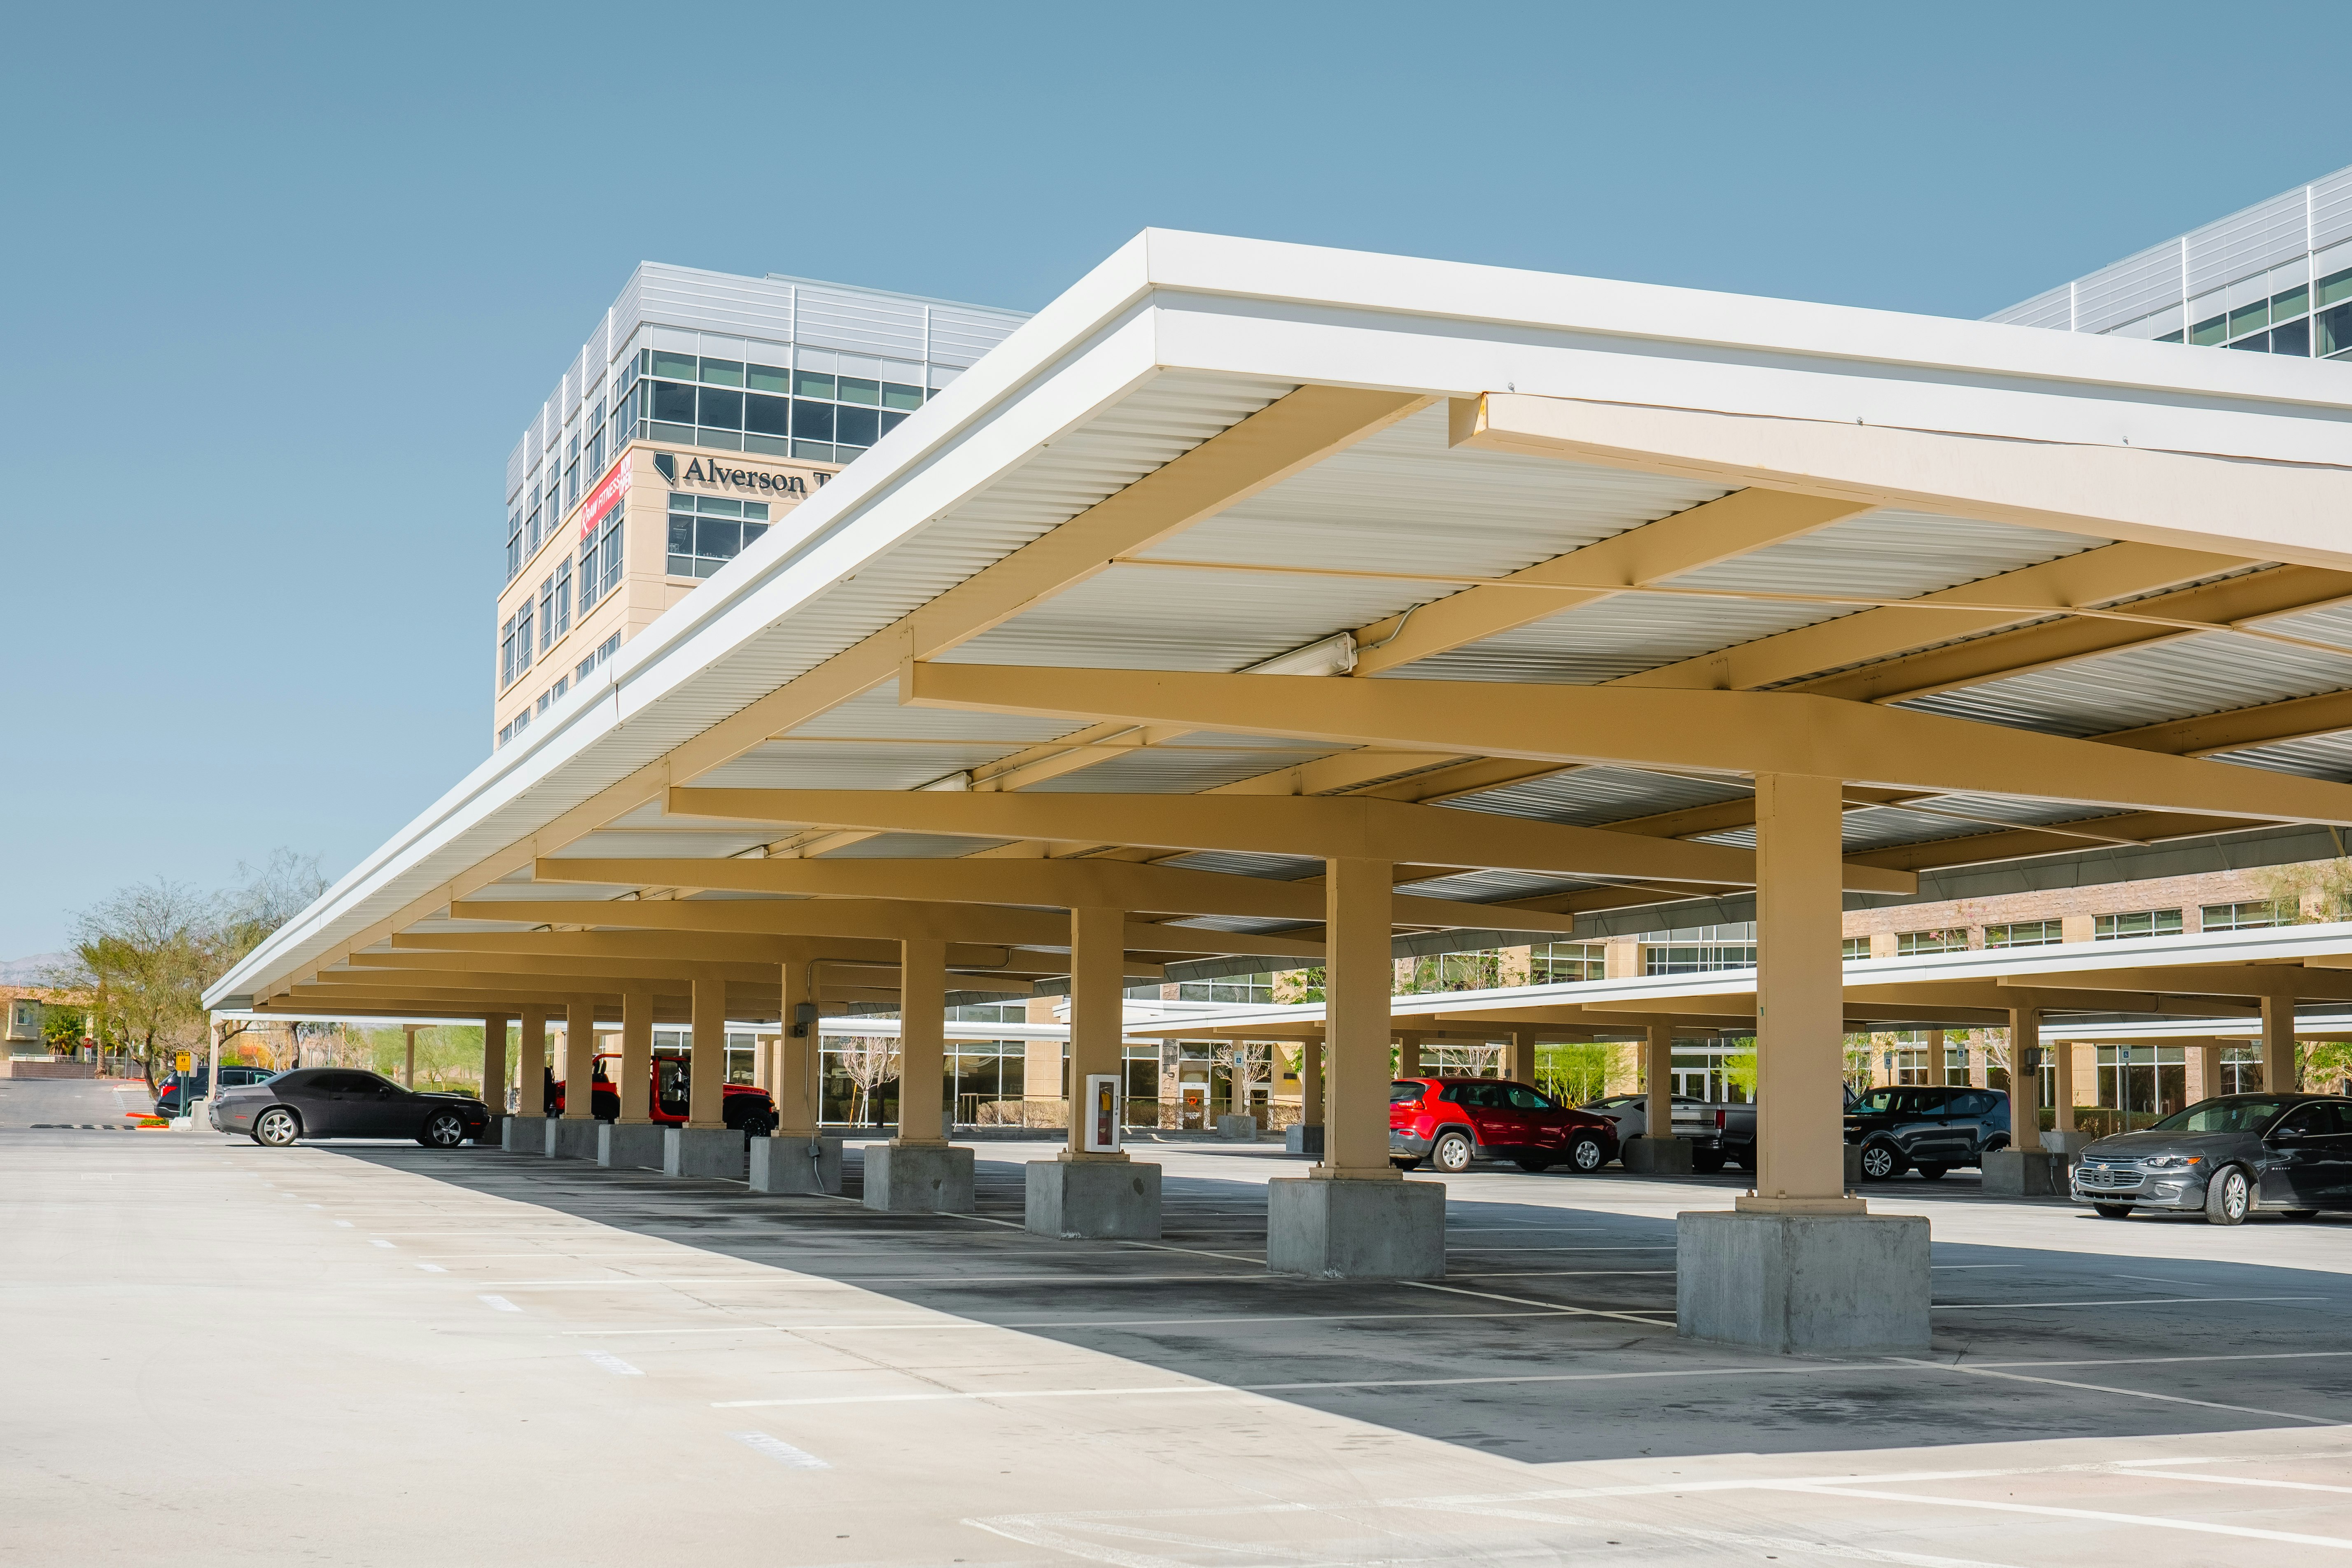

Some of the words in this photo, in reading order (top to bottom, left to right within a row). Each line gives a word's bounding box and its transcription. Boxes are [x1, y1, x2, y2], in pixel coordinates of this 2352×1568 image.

[620, 451, 632, 478] NOW
[682, 457, 806, 493] Alverson
[586, 497, 598, 524] RAW
[598, 473, 621, 510] FITNESS
[619, 468, 632, 497] OPEN
